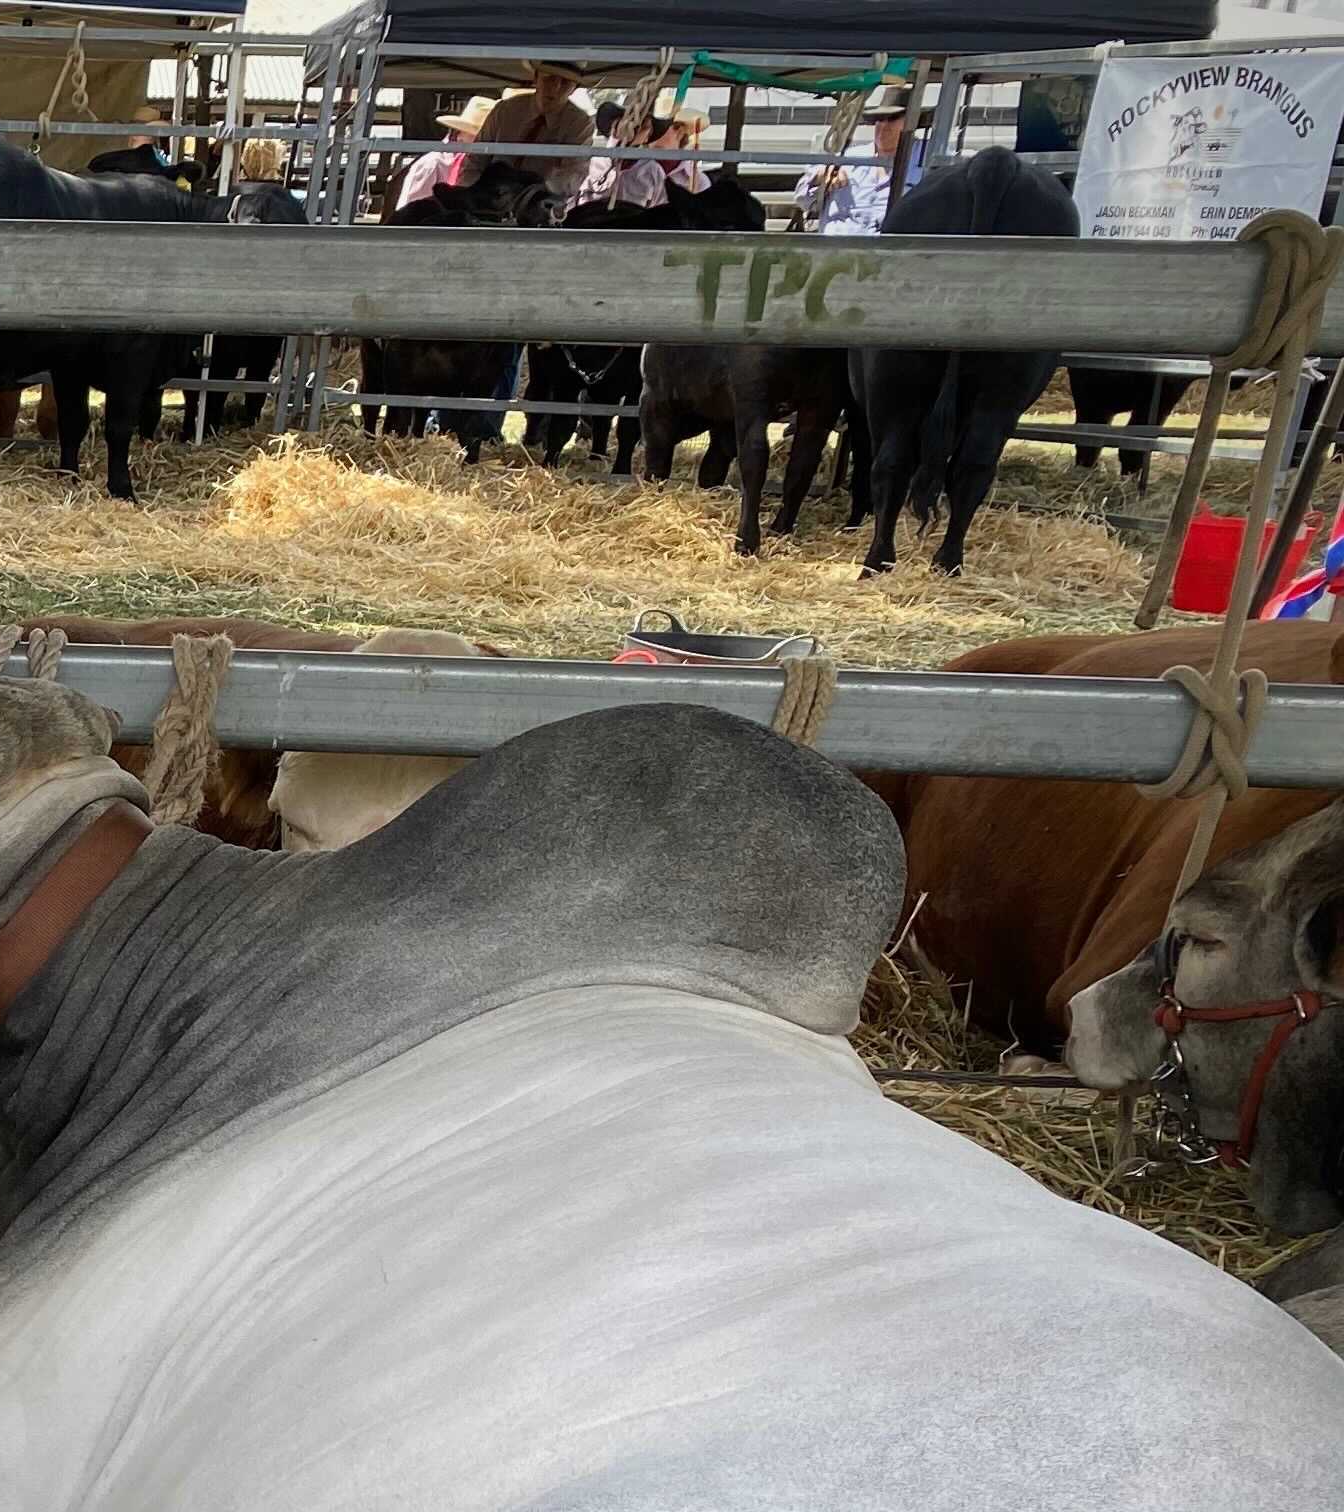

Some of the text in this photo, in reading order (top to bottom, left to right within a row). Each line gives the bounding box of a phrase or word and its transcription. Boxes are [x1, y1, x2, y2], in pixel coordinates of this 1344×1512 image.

[1107, 65, 1314, 142] ROCKYVIEW BRANGUS
[1095, 206, 1126, 218] JASON
[1200, 206, 1226, 219] ERIN
[1210, 226, 1237, 239] 0447
[663, 245, 881, 336] TPC
